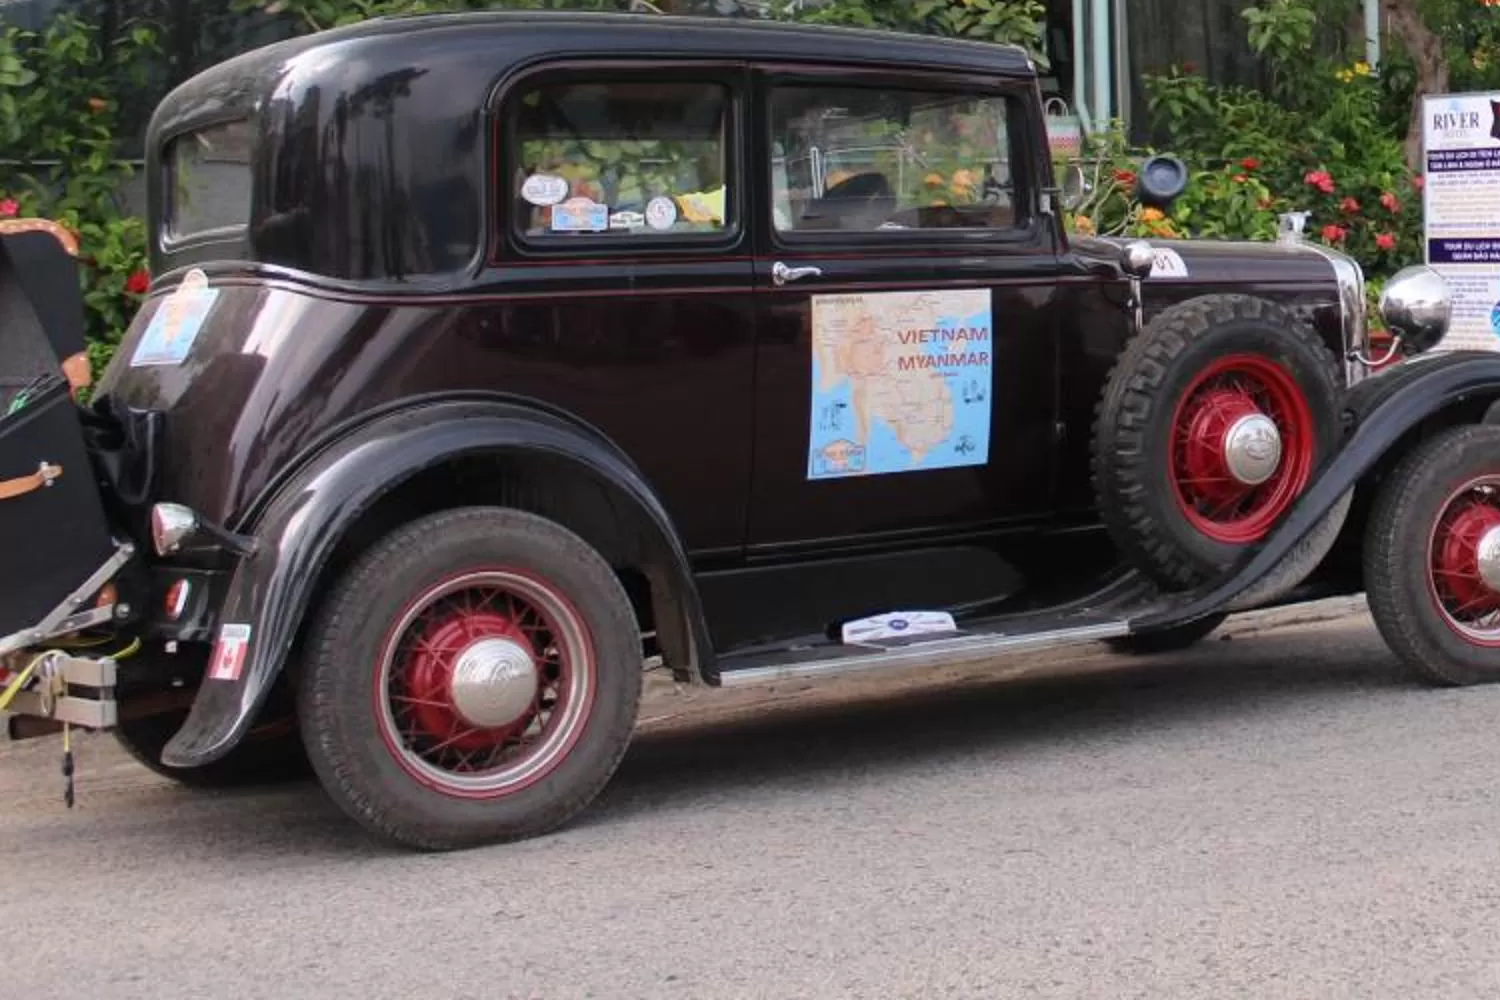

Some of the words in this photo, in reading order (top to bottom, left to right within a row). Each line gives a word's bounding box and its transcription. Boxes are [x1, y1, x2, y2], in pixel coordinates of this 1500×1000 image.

[1433, 111, 1480, 130] RIVER
[897, 327, 988, 345] VIETNAM
[897, 351, 989, 371] MYANMAR
